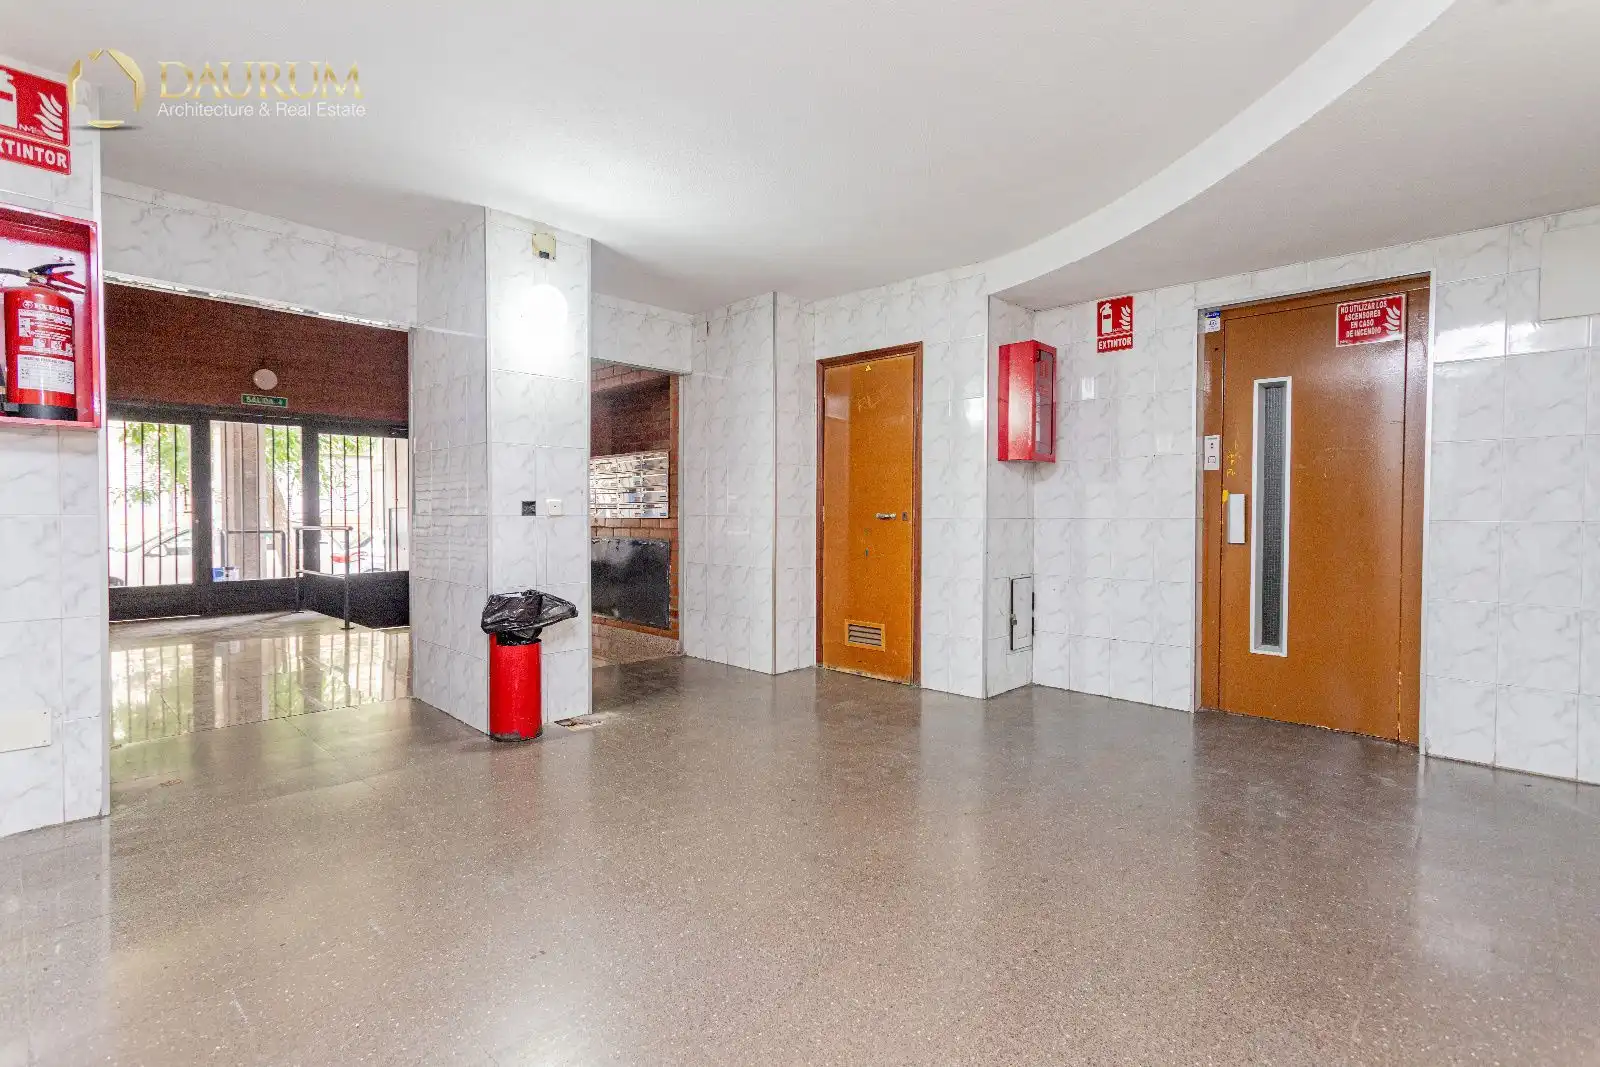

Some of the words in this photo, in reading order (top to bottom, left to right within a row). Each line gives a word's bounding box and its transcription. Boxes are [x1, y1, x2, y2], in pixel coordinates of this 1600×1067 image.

[1340, 306, 1349, 314] NO
[1350, 303, 1375, 313] UTILIZAR
[1376, 300, 1387, 309] LOS
[1344, 309, 1381, 321] ASCENSORES
[1350, 321, 1358, 329] EN
[1359, 319, 1374, 328] CASO
[1346, 330, 1354, 338] DE
[1355, 327, 1381, 336] INCENDIO
[1098, 337, 1131, 349] EXTINTOR
